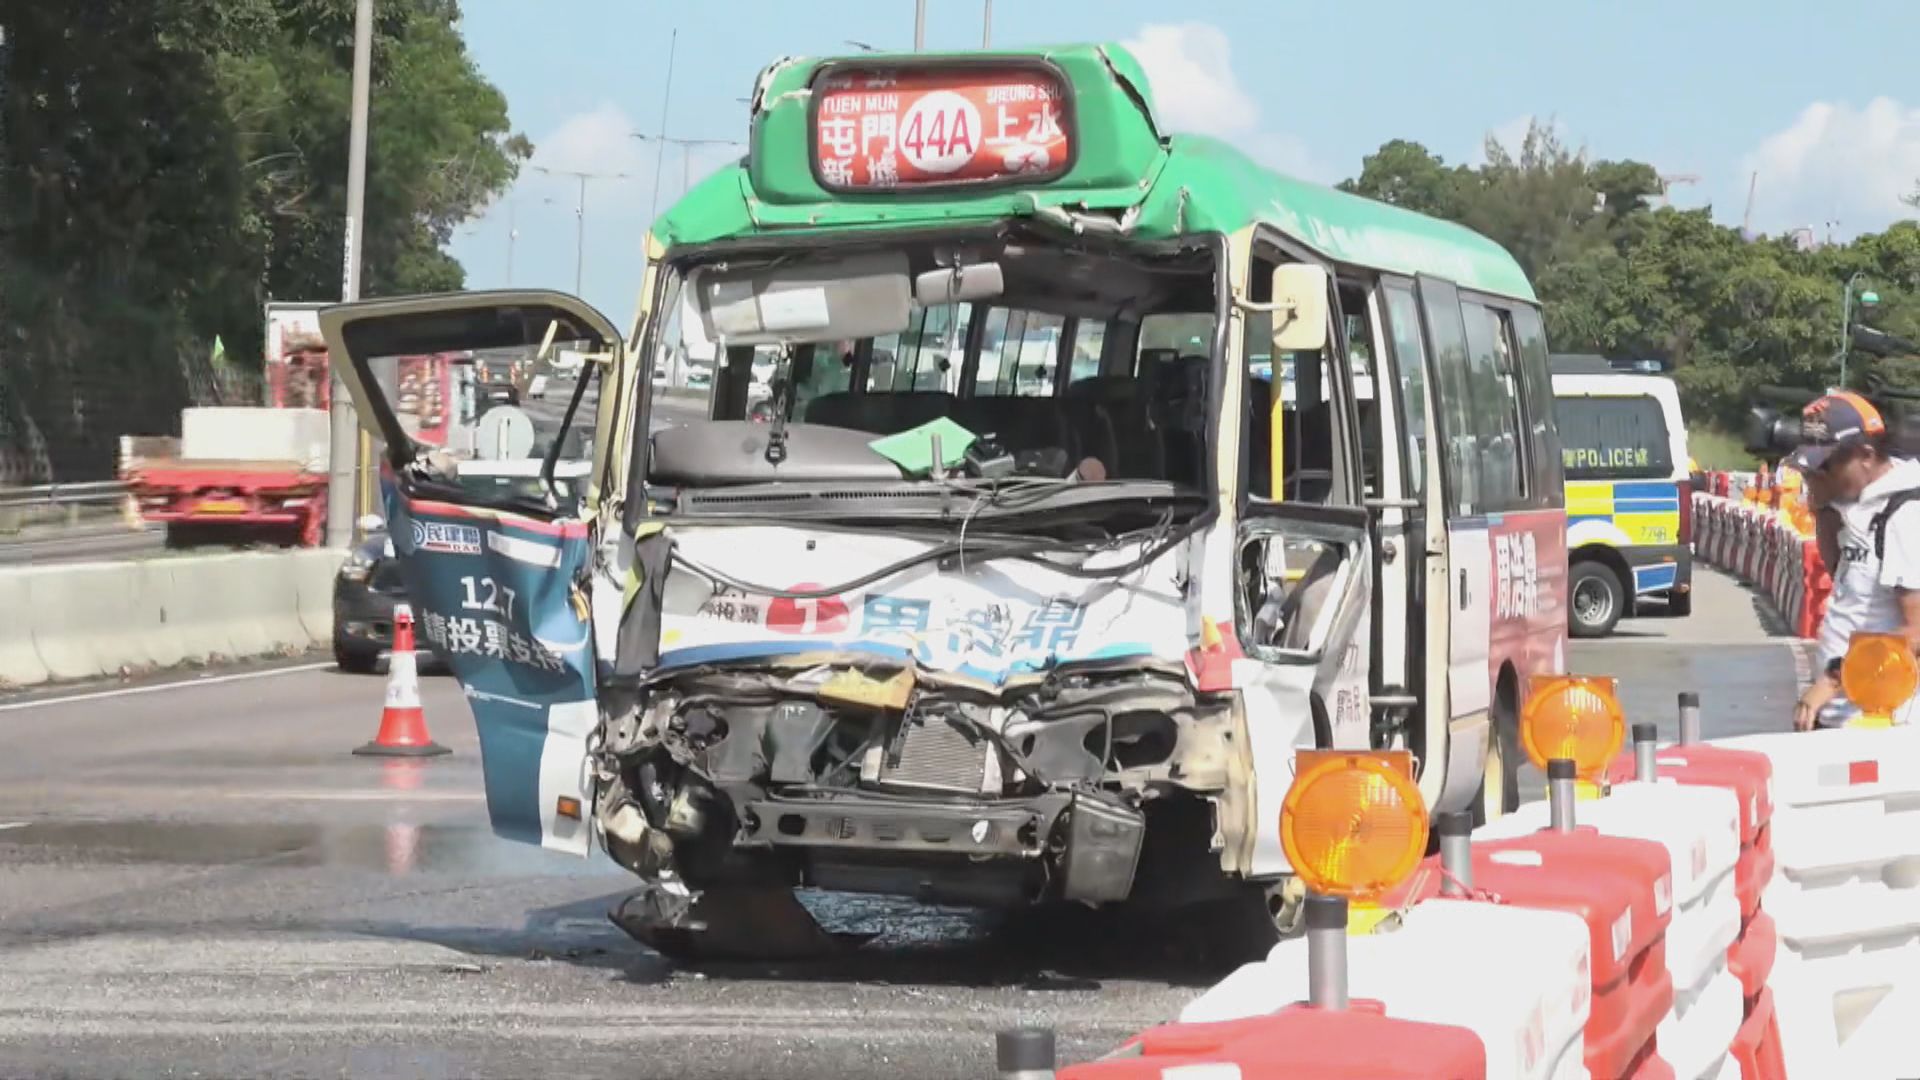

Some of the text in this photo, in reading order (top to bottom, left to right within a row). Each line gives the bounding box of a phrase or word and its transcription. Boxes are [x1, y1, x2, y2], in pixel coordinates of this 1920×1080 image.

[824, 93, 898, 114] TUEN MUN
[985, 101, 1063, 145] 上水
[821, 114, 897, 156] 屯門
[905, 108, 973, 160] 44A
[1577, 448, 1633, 468] POLICE
